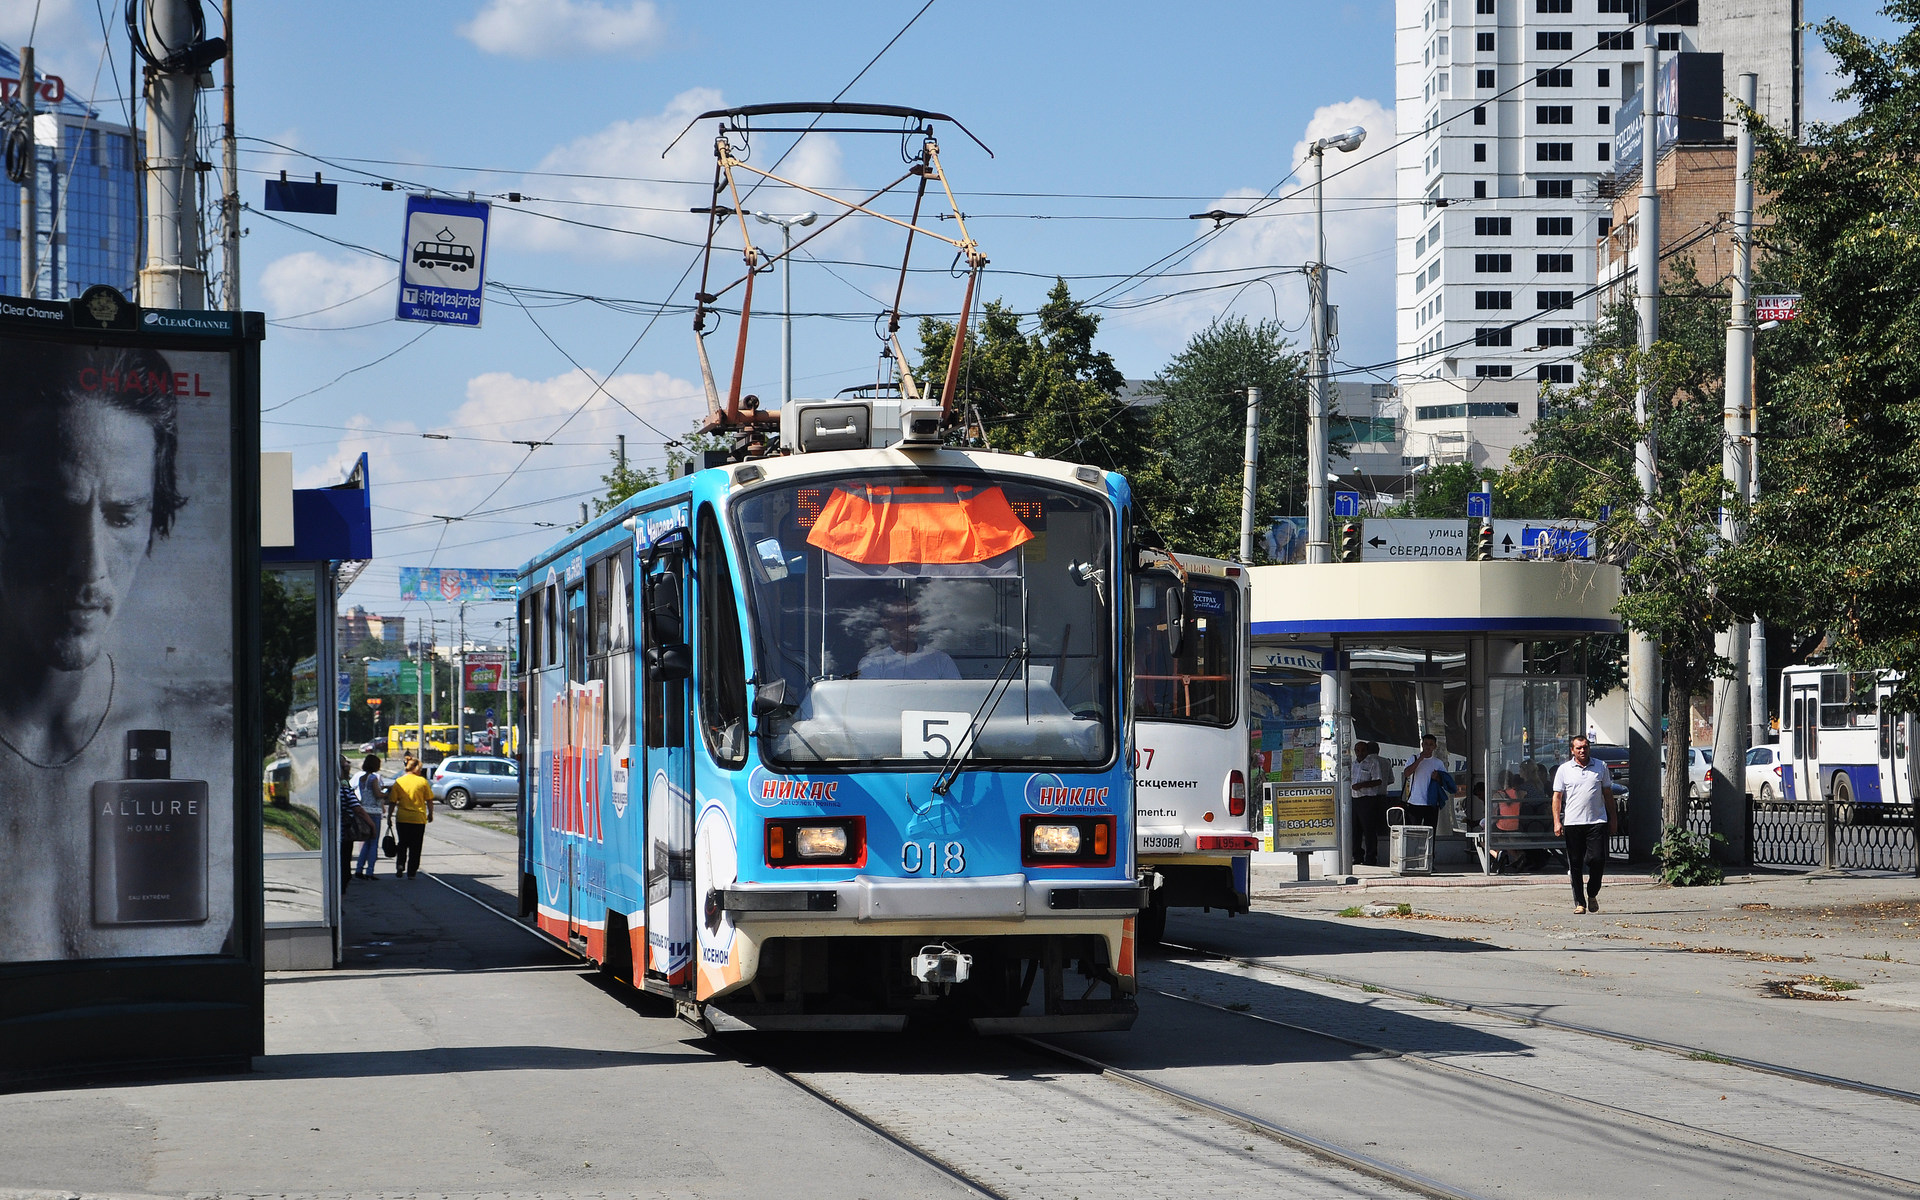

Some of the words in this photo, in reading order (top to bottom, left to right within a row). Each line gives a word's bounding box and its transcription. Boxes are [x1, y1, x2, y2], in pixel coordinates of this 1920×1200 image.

[2, 303, 25, 316] Clear
[26, 306, 63, 320] Channel
[431, 309, 468, 320] ВОКЗАЛ
[79, 367, 212, 397] CHANEL
[797, 490, 820, 527] 5
[1429, 529, 1464, 539] улица
[1389, 545, 1463, 557] СВЕРДЛОВА
[922, 719, 952, 760] 5
[761, 780, 838, 801] НИКАС
[1039, 787, 1109, 806] НИКАС
[1278, 788, 1333, 797] БЕСПЛАТНО
[102, 800, 198, 816] ALLURE
[127, 824, 171, 832] HOMME
[1288, 819, 1334, 829] 361-14-54
[901, 841, 966, 876] 018
[703, 947, 729, 965] КСЕНОН
